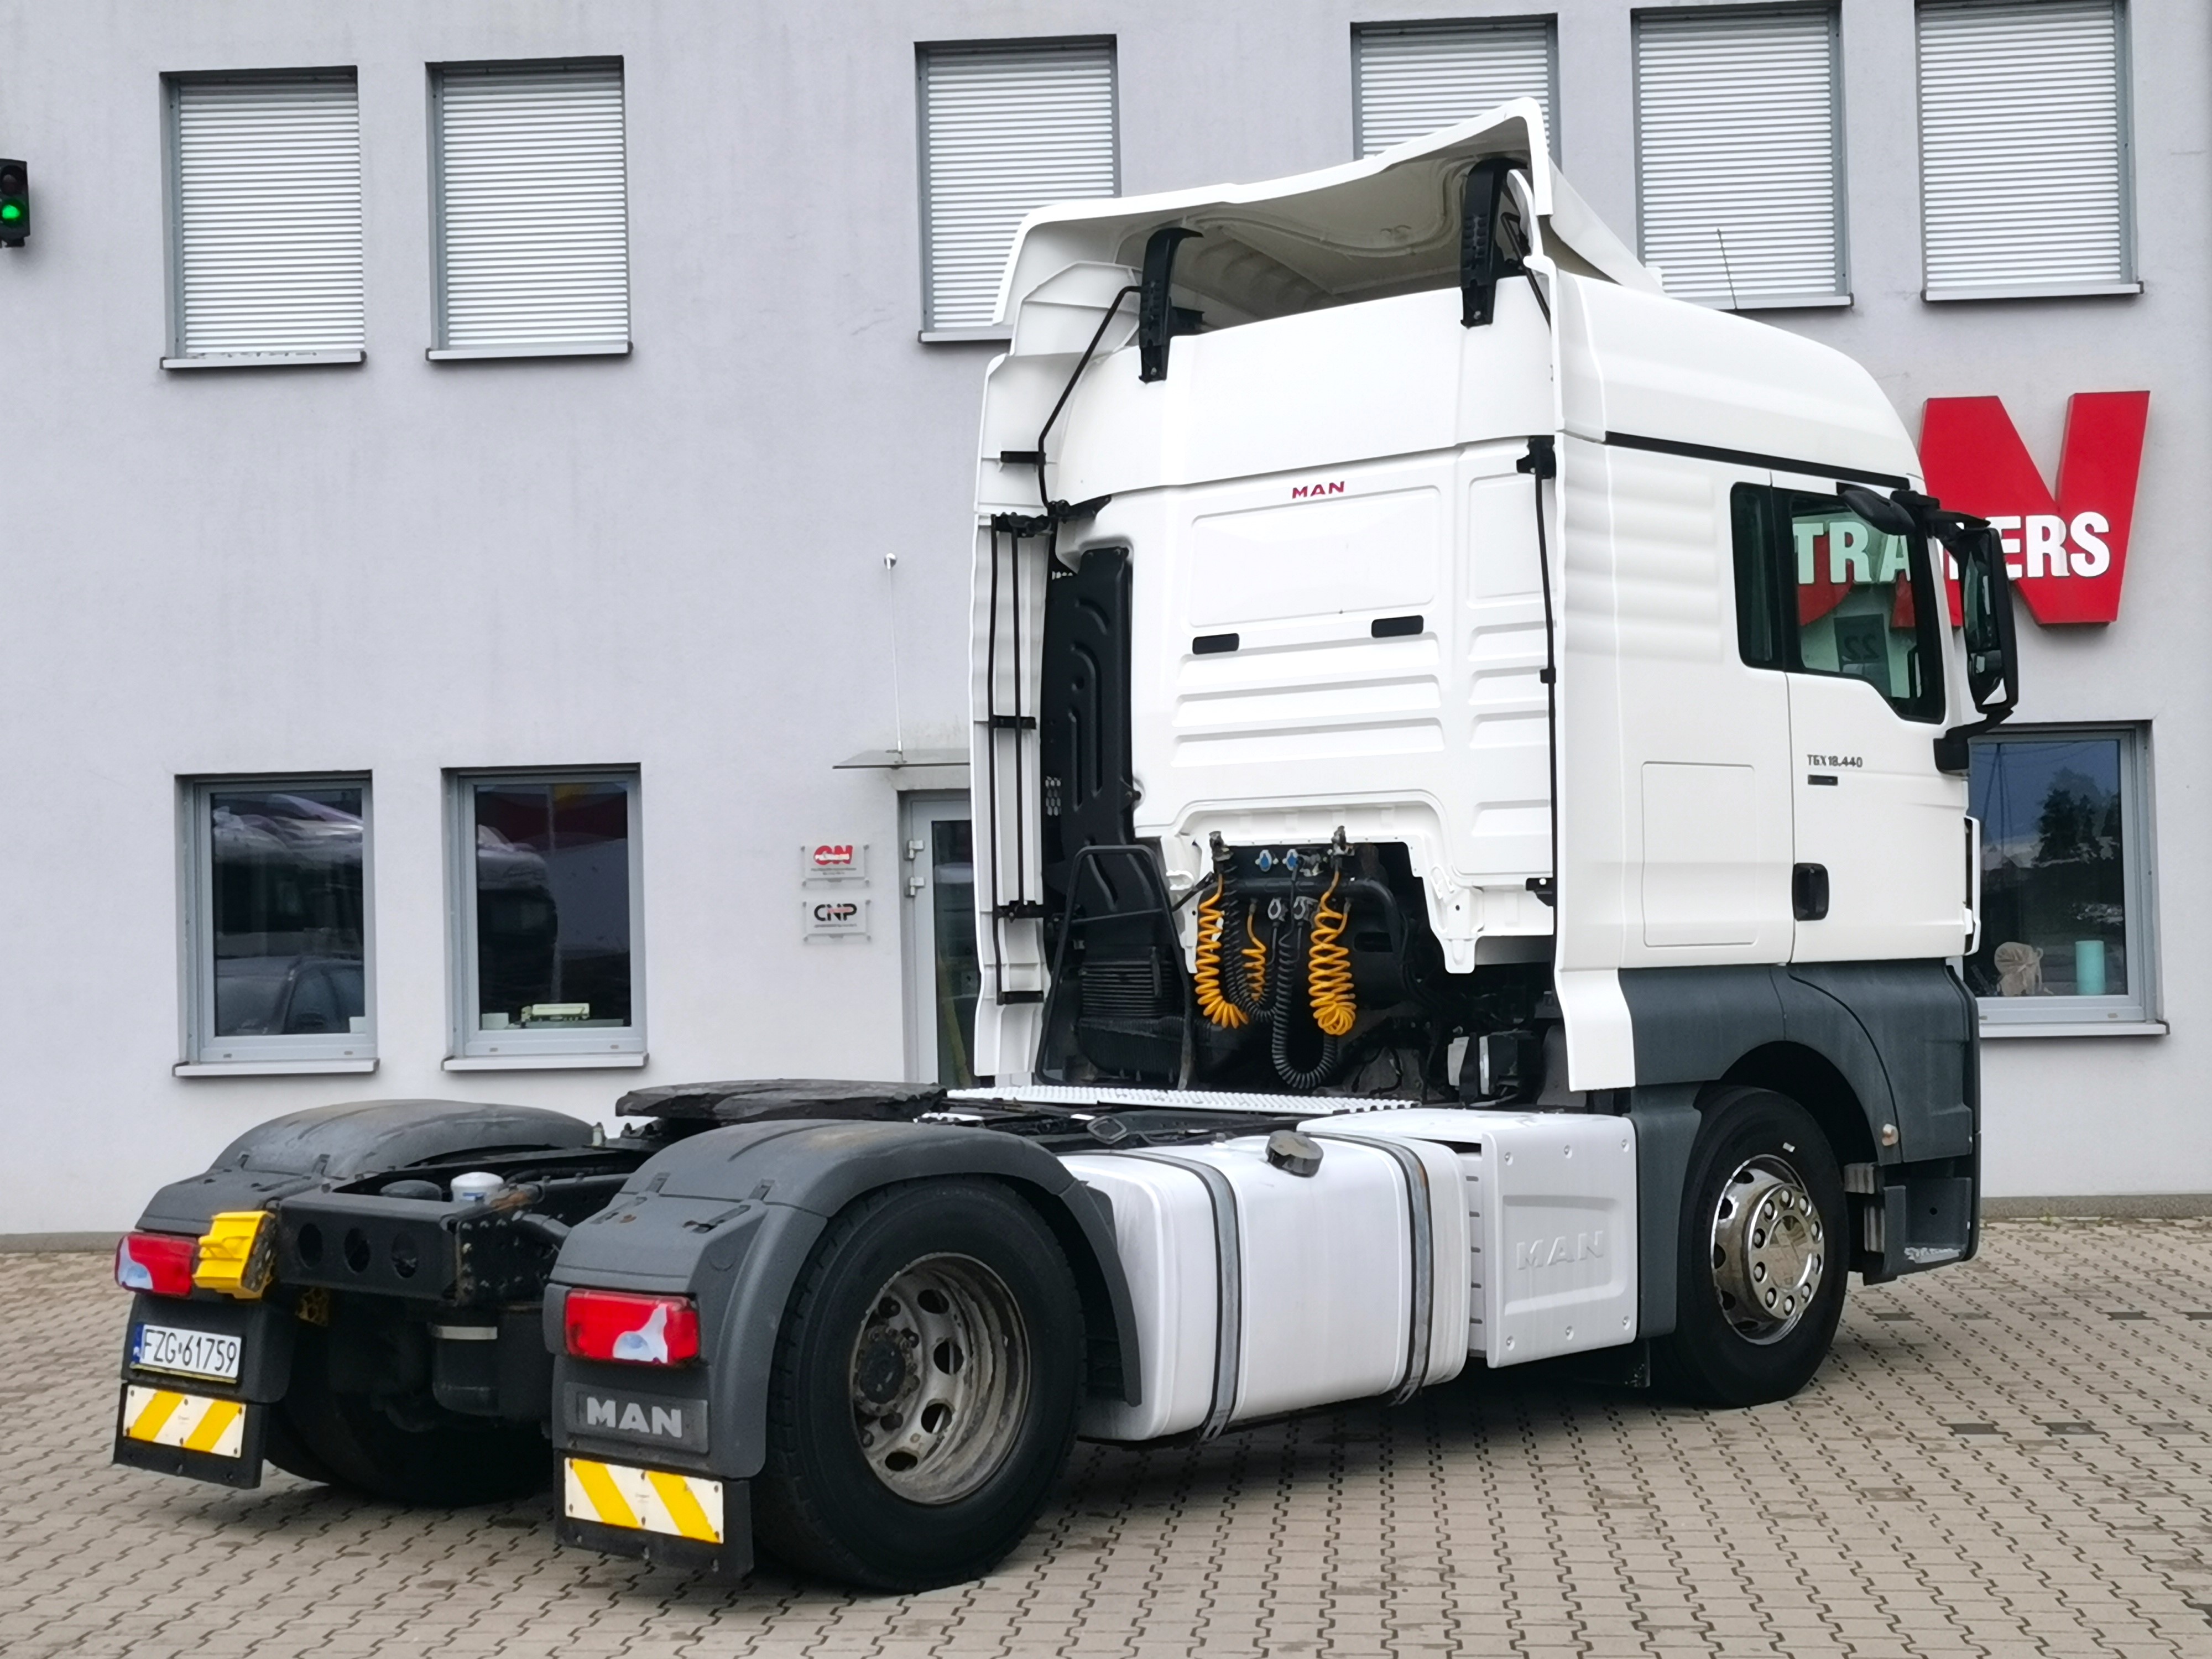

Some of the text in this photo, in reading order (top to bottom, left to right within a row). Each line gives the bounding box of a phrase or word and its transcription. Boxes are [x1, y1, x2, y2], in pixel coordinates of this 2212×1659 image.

[1292, 481, 1345, 499] MAN
[1792, 512, 2111, 584] TRAERS
[1807, 754, 1863, 768] TGX 18.440
[814, 903, 857, 922] CNP
[1516, 1230, 1604, 1270] MAN
[142, 1328, 237, 1374] FZG 61759
[586, 1396, 682, 1438] MAN
